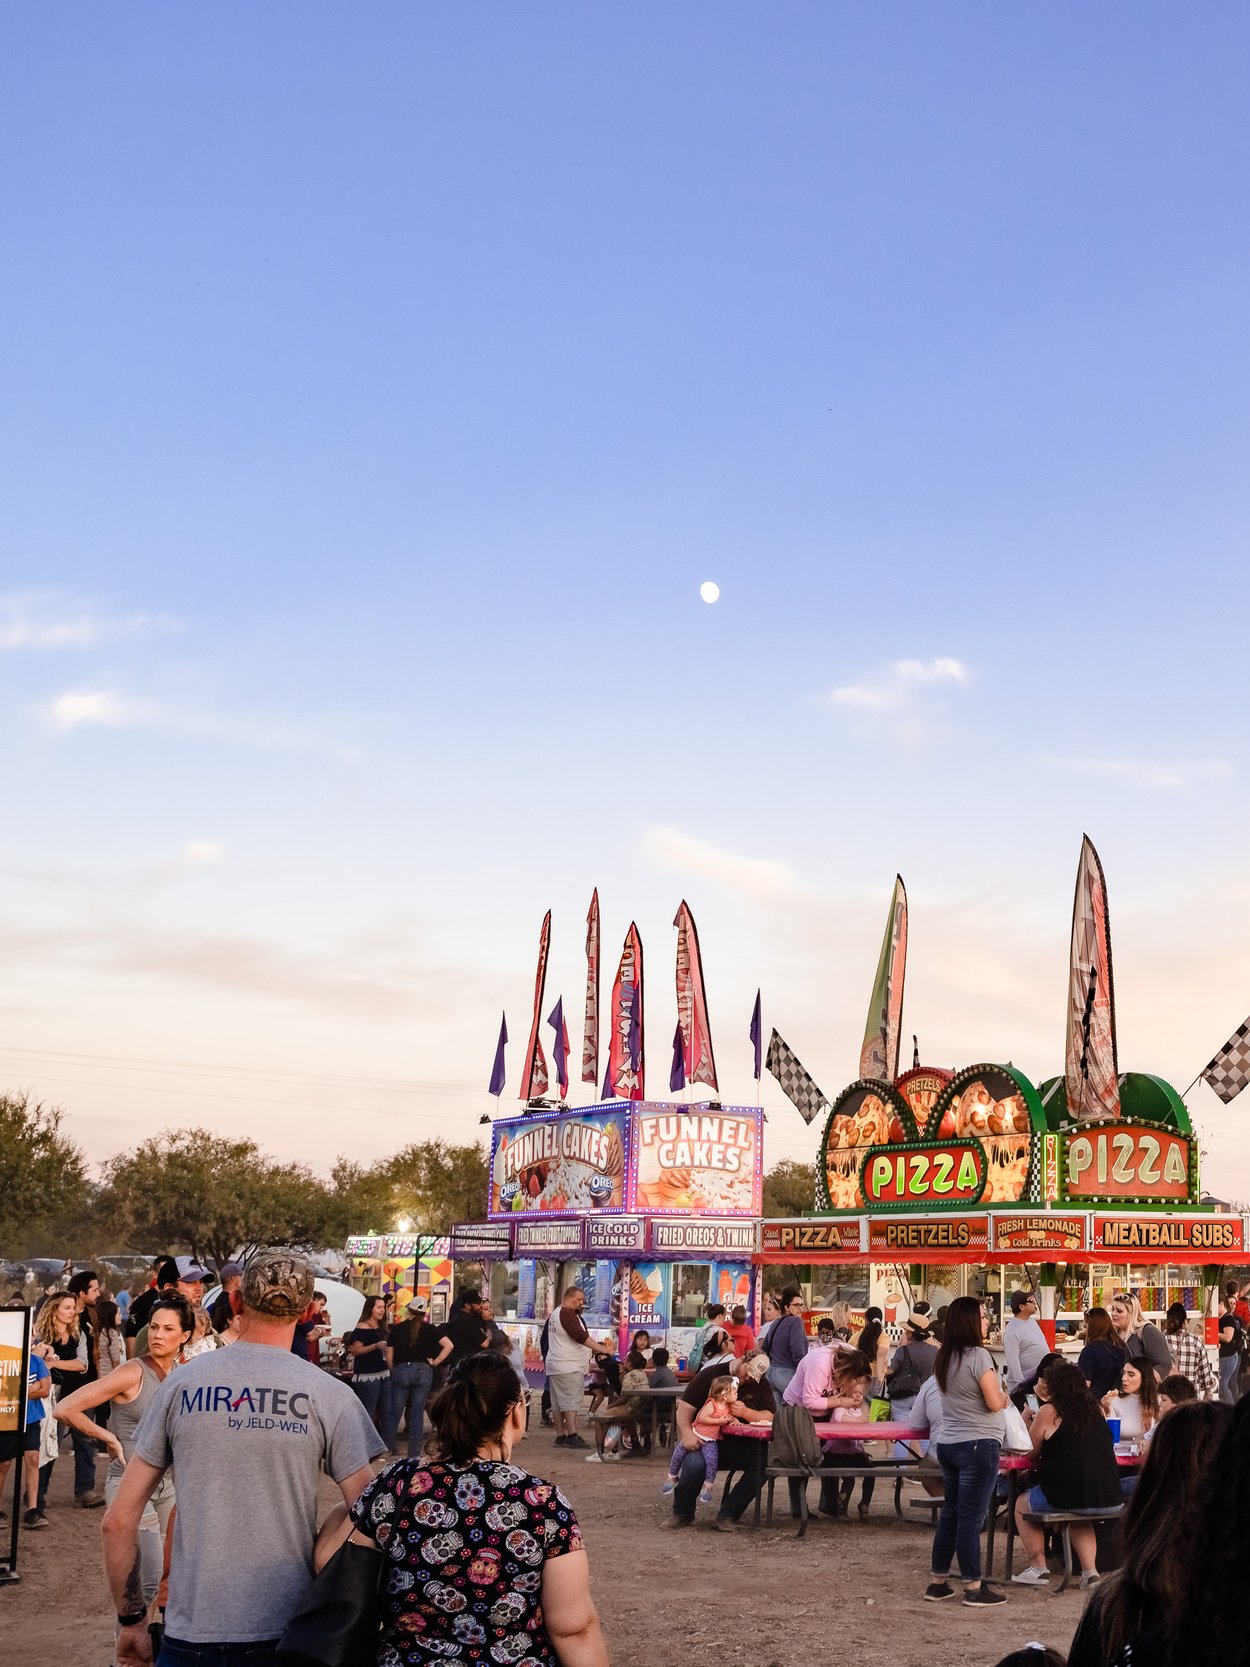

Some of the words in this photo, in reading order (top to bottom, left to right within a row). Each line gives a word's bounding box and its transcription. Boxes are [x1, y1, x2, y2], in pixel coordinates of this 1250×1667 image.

[906, 1077, 941, 1095] PRETZELS
[641, 1115, 751, 1148] FUNNEL
[506, 1124, 559, 1181] FUNNEL
[562, 1124, 609, 1171] CAKES
[659, 1141, 741, 1171] CAKES
[1068, 1133, 1187, 1184] PIZZA
[872, 1151, 979, 1198] PIZZA
[1046, 1136, 1056, 1199] PIZZA
[500, 1183, 519, 1199] OREO
[591, 1176, 614, 1190] OREO
[589, 1223, 604, 1235] ICE
[606, 1223, 640, 1235] COLD
[657, 1226, 684, 1246] FRIED
[685, 1226, 715, 1246] OREOS
[716, 1228, 725, 1246] &
[781, 1227, 842, 1248] PIZZA
[887, 1224, 969, 1247] PRETZELS
[997, 1219, 1024, 1236] FRESH
[1027, 1219, 1081, 1236] LEMONADE
[1104, 1222, 1189, 1247] MEATBALL
[1192, 1224, 1234, 1247] SUBS
[591, 1235, 637, 1247] DRINKS
[1012, 1238, 1030, 1248] Cold
[1032, 1238, 1062, 1248] Drinks
[638, 1303, 654, 1313] ICE
[629, 1314, 661, 1324] CREAM
[180, 1386, 310, 1420] MIRATEC
[228, 1417, 243, 1430] by
[246, 1417, 308, 1435] JELD-WEN
